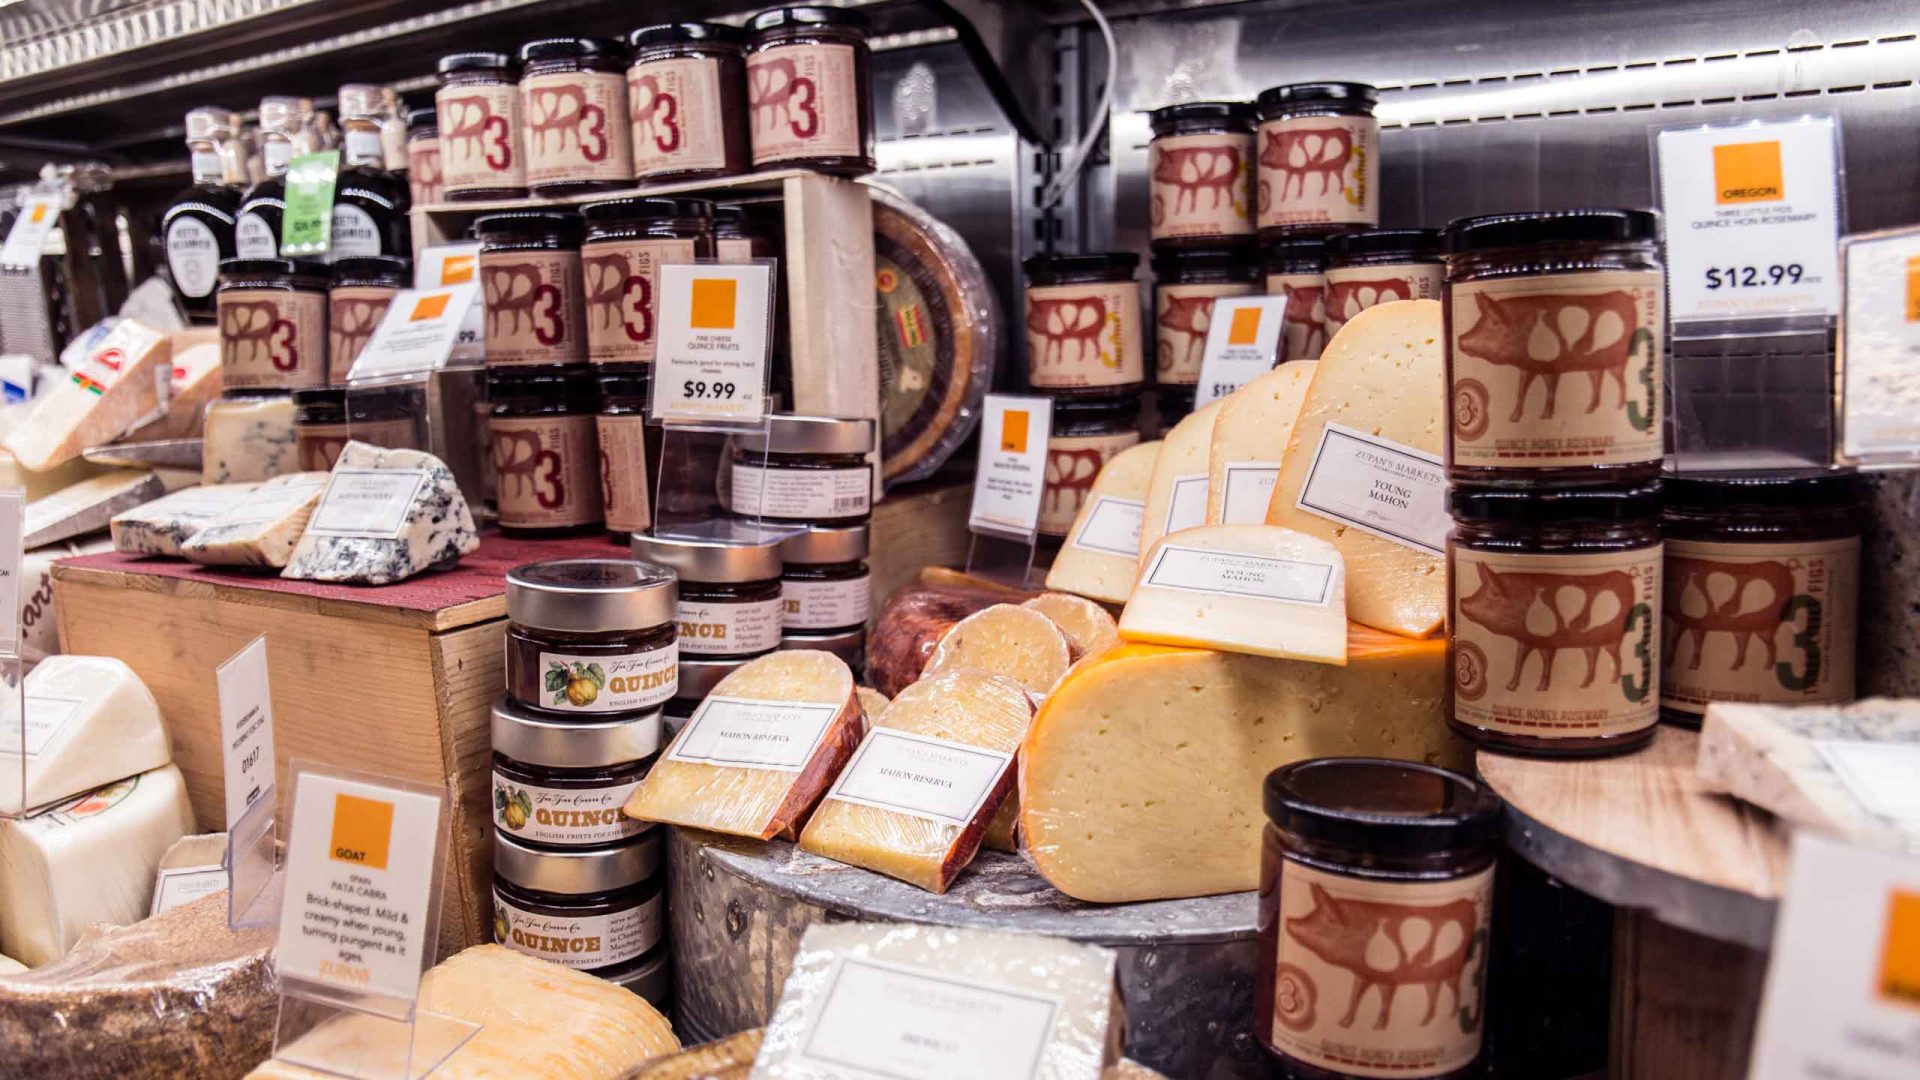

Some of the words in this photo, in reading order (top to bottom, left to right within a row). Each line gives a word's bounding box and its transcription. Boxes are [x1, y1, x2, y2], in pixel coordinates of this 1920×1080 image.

[789, 77, 818, 138] 3
[579, 104, 608, 162] 3
[653, 93, 680, 153] 3
[484, 115, 511, 171] 3
[1722, 186, 1778, 199] OREGON
[1692, 219, 1731, 230] QUINCE
[1761, 213, 1817, 225] ROSEMARY
[638, 251, 651, 275] FIGS
[1705, 263, 1803, 290] $12.99
[534, 284, 564, 346] 3
[623, 276, 653, 342] 3
[1646, 289, 1656, 326] FIGS
[271, 320, 298, 371] 3
[688, 342, 715, 350] QUINCE
[716, 343, 740, 351] FRUITS
[1626, 327, 1656, 432] 3
[683, 380, 736, 400] $9.99
[1494, 438, 1528, 450] QUINCE
[1531, 438, 1564, 450] HONEY
[1566, 436, 1614, 450] ROSEMARY
[1355, 449, 1394, 468] ZUPAN'S
[1395, 463, 1442, 484] MARKETS
[534, 450, 565, 510] 3
[1374, 479, 1412, 499] YOUNG
[1368, 489, 1409, 509] MAHON
[1221, 573, 1266, 584] MAHON
[1224, 568, 1267, 578] YOUNG
[1643, 566, 1654, 600] FIGS
[1808, 558, 1825, 593] FIGS
[671, 621, 727, 639] INCE
[1621, 602, 1651, 703] 3
[1776, 594, 1822, 692] 3
[609, 662, 677, 694] QUINCE
[609, 698, 638, 707] ENGLISH
[1678, 684, 1708, 694] HONEY
[1710, 687, 1762, 703] ROSEMARY
[1492, 704, 1523, 719] QUINCE
[1527, 709, 1559, 721] HONEY
[1560, 709, 1609, 721] ROSEMARY
[752, 732, 791, 743] RESERVA
[242, 746, 260, 774] 01617
[913, 774, 953, 790] RESERVA
[536, 793, 552, 804] THE
[551, 793, 571, 806] FINE
[573, 793, 599, 808] CHEESE
[535, 807, 628, 828] QUINCE
[535, 830, 564, 839] ENGLISH
[567, 831, 592, 840] FRUITS
[593, 831, 607, 839] FOR
[336, 848, 366, 862] GOAT
[350, 875, 371, 886] SPAIN
[331, 881, 355, 895] PATA
[356, 885, 388, 901] CABRA
[306, 892, 371, 916] Brick-shaped.
[375, 908, 398, 921] Mild
[401, 913, 409, 925] &
[610, 917, 625, 925] serve
[626, 911, 640, 920] with
[304, 910, 340, 929] creamy
[342, 917, 369, 930] when
[371, 923, 407, 942] young,
[524, 917, 541, 928] FINE
[542, 921, 567, 933] CHEESE
[610, 924, 624, 934] hard
[302, 926, 337, 944] turning
[340, 933, 383, 951] pungent
[385, 944, 396, 954] as
[399, 947, 406, 957] it
[512, 928, 601, 953] QUINCE
[338, 951, 363, 964] ages.
[576, 957, 602, 965] CHEESE
